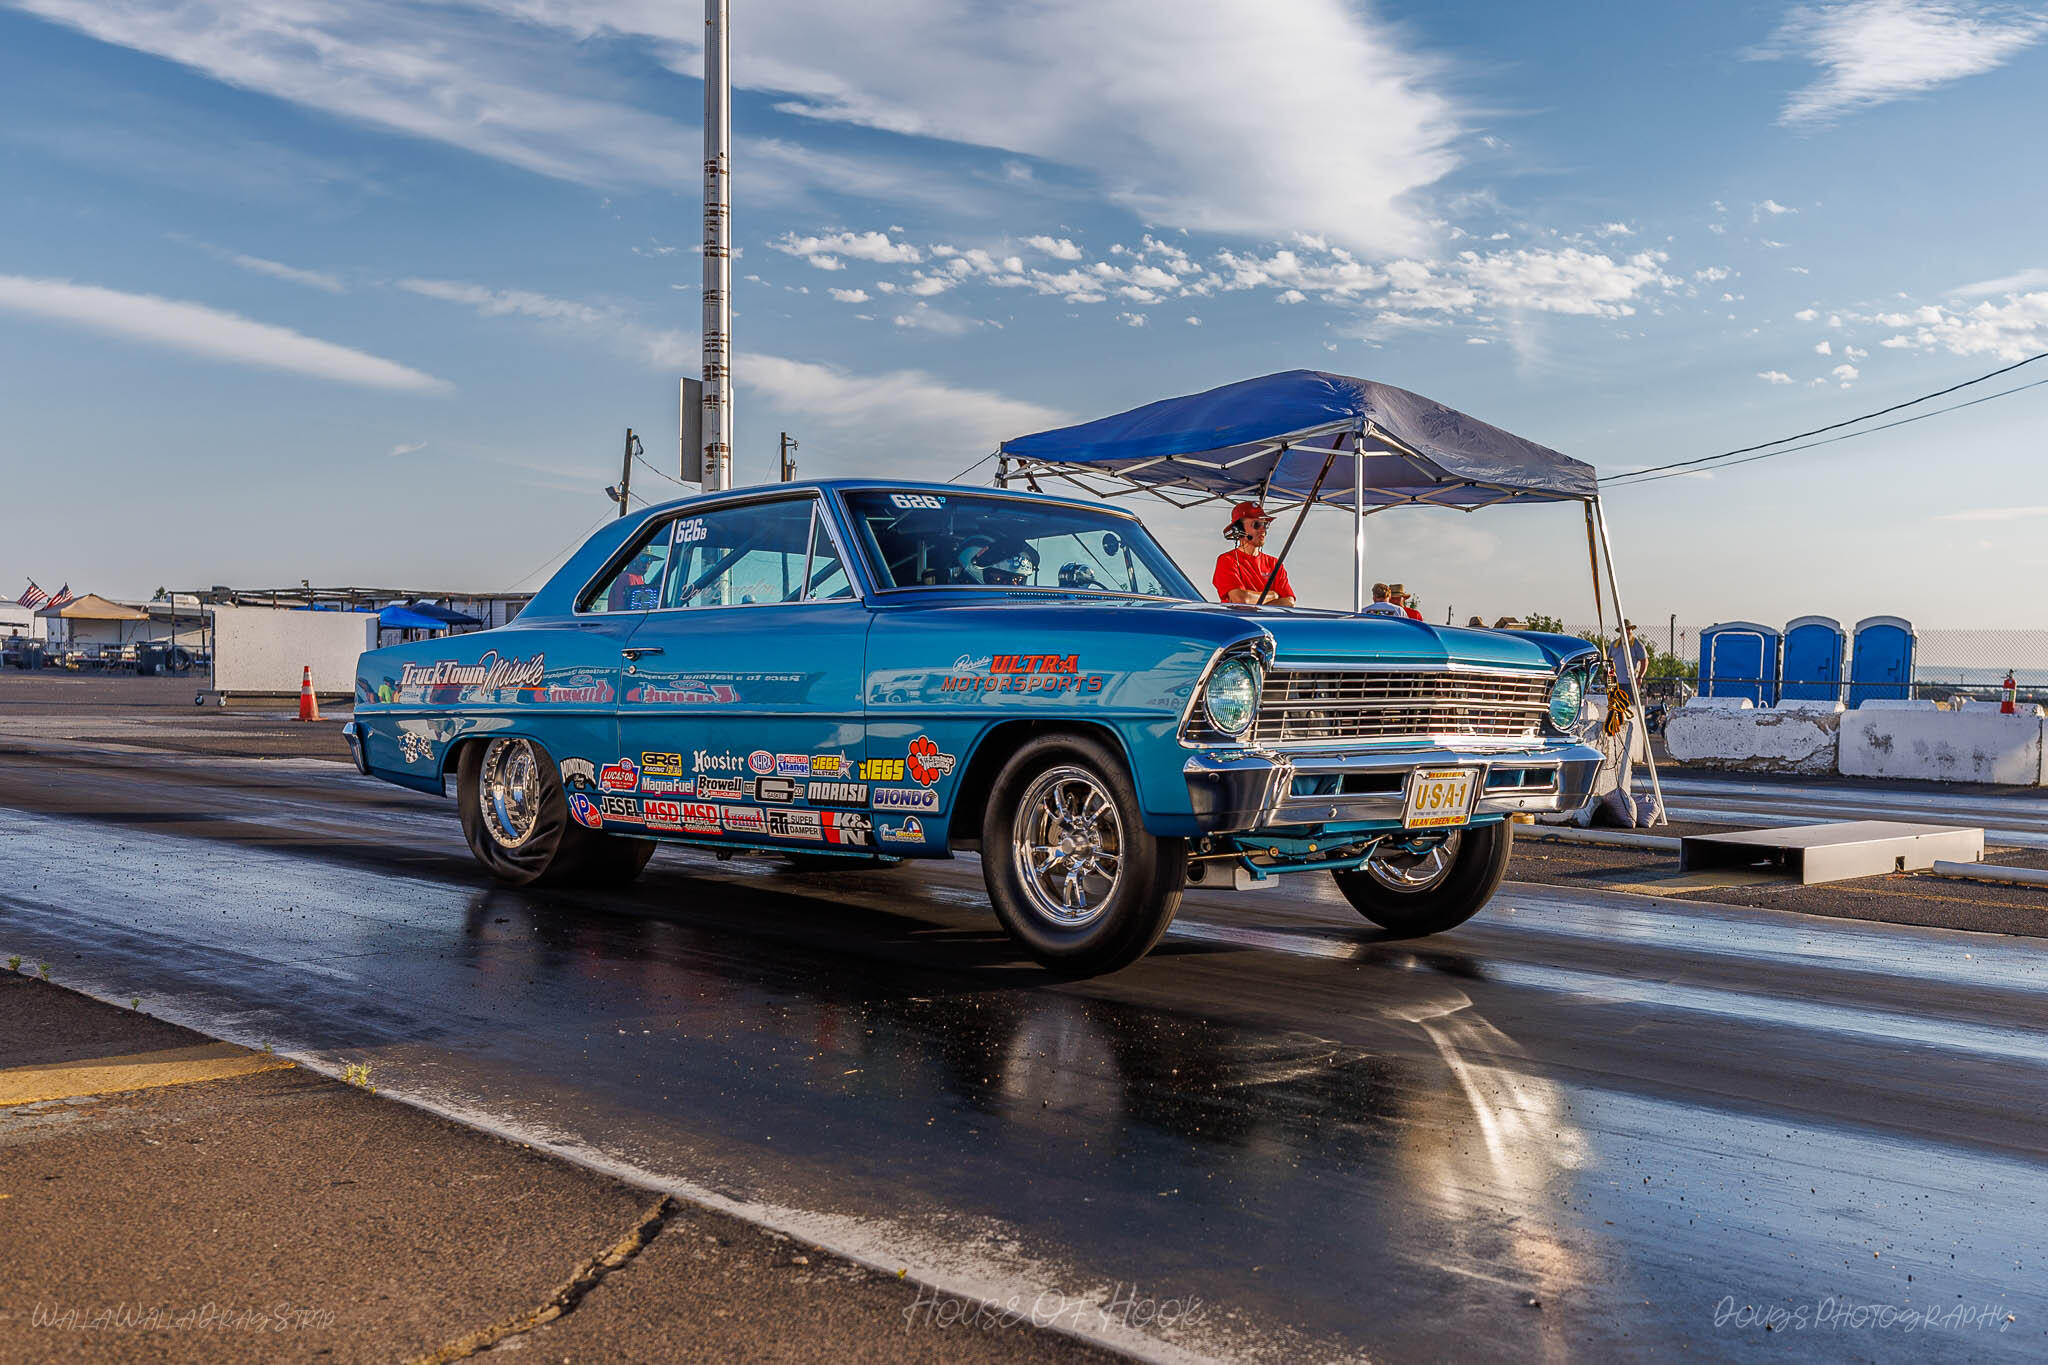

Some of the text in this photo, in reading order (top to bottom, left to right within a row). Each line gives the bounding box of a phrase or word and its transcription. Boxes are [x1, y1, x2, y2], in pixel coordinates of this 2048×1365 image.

[891, 494, 942, 509] 626
[479, 648, 545, 695] Missile
[990, 654, 1080, 674] ULTRA
[941, 676, 1102, 692] MOTORSPORTS
[691, 749, 744, 772] Hoosier
[752, 755, 772, 770] NHRA
[778, 762, 809, 773] Strange
[812, 757, 840, 770] JEGS
[604, 771, 634, 782] LUCAS OIL
[858, 759, 904, 781] JEGS
[641, 777, 694, 794] MagnaFuel
[699, 776, 741, 791] Browell
[808, 782, 868, 803] MOROSO
[874, 789, 934, 806] BIONDO
[601, 797, 643, 817] JESEL
[645, 801, 680, 822] MSD
[683, 803, 718, 824] MSD
[791, 815, 814, 824] SUPER
[1410, 817, 1450, 827] ALAN GREEN
[790, 826, 819, 835] DAMPER
